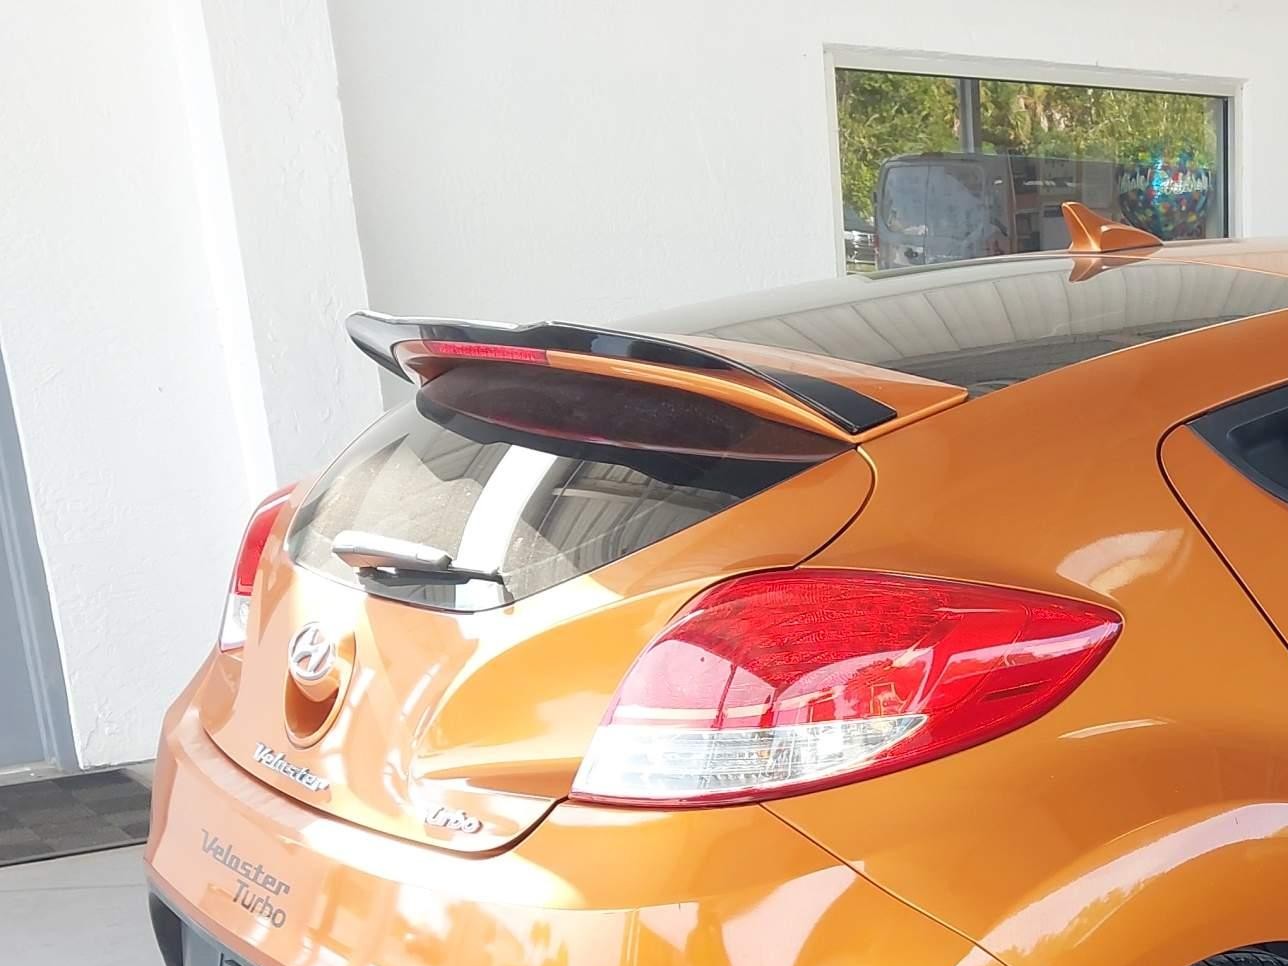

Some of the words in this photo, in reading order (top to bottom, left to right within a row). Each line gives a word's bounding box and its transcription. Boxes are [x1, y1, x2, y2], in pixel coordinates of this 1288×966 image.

[254, 743, 330, 792] Veloster
[200, 828, 291, 897] Veloster
[232, 879, 288, 929] Turbo
